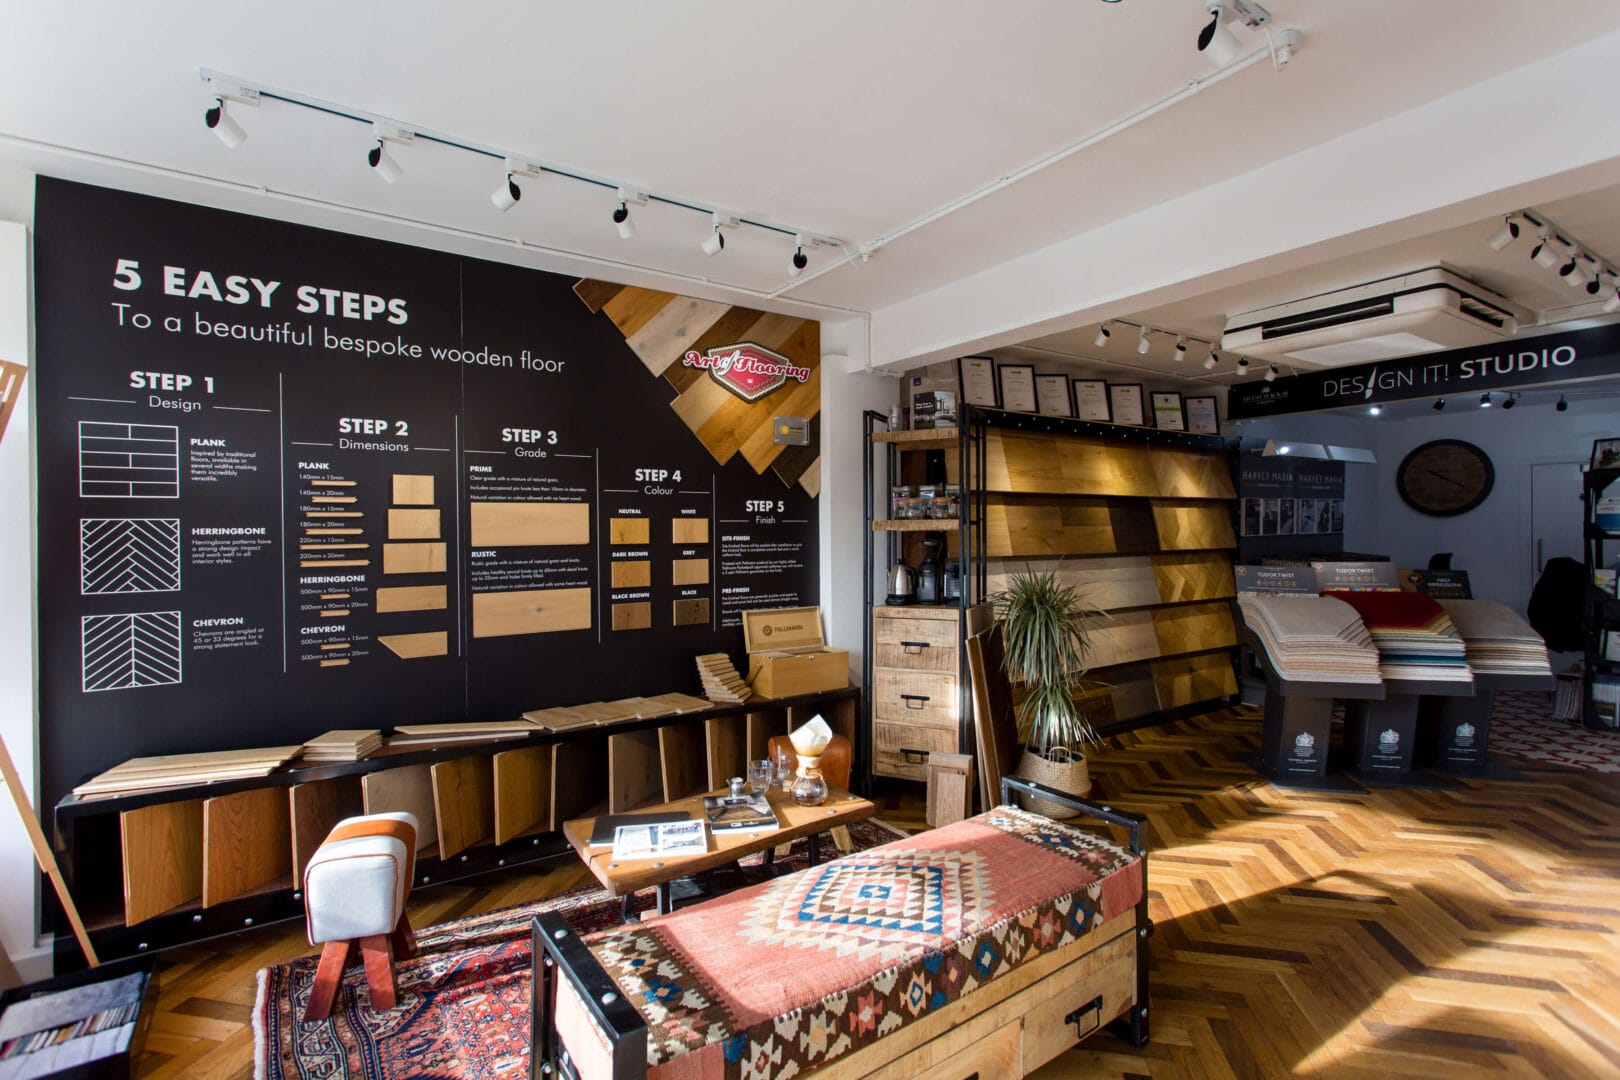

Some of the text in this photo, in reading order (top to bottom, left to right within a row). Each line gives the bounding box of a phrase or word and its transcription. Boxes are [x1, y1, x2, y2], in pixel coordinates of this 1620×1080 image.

[112, 258, 409, 326] 5 EASY STEPS
[112, 302, 565, 372] To a beautiful bespoke wooden floor
[683, 350, 810, 383] Art of Flooring
[1423, 364, 1449, 384] IT!
[1459, 345, 1576, 379] STUDIO
[129, 370, 214, 394] STEP 1
[149, 395, 202, 412] Design
[339, 418, 408, 436] STEP 2
[190, 438, 226, 447] PLANK
[502, 428, 558, 444] STEP 3
[339, 438, 409, 452] Dimensions
[514, 446, 547, 458] Grade
[635, 468, 681, 482] STEP 4
[644, 486, 674, 495] Colour
[746, 500, 784, 512] STEP 5
[755, 515, 776, 524] Finish
[300, 575, 365, 584] HERRINGBONE
[193, 617, 244, 627] CHEVRON
[301, 625, 345, 634] CHEVRON
